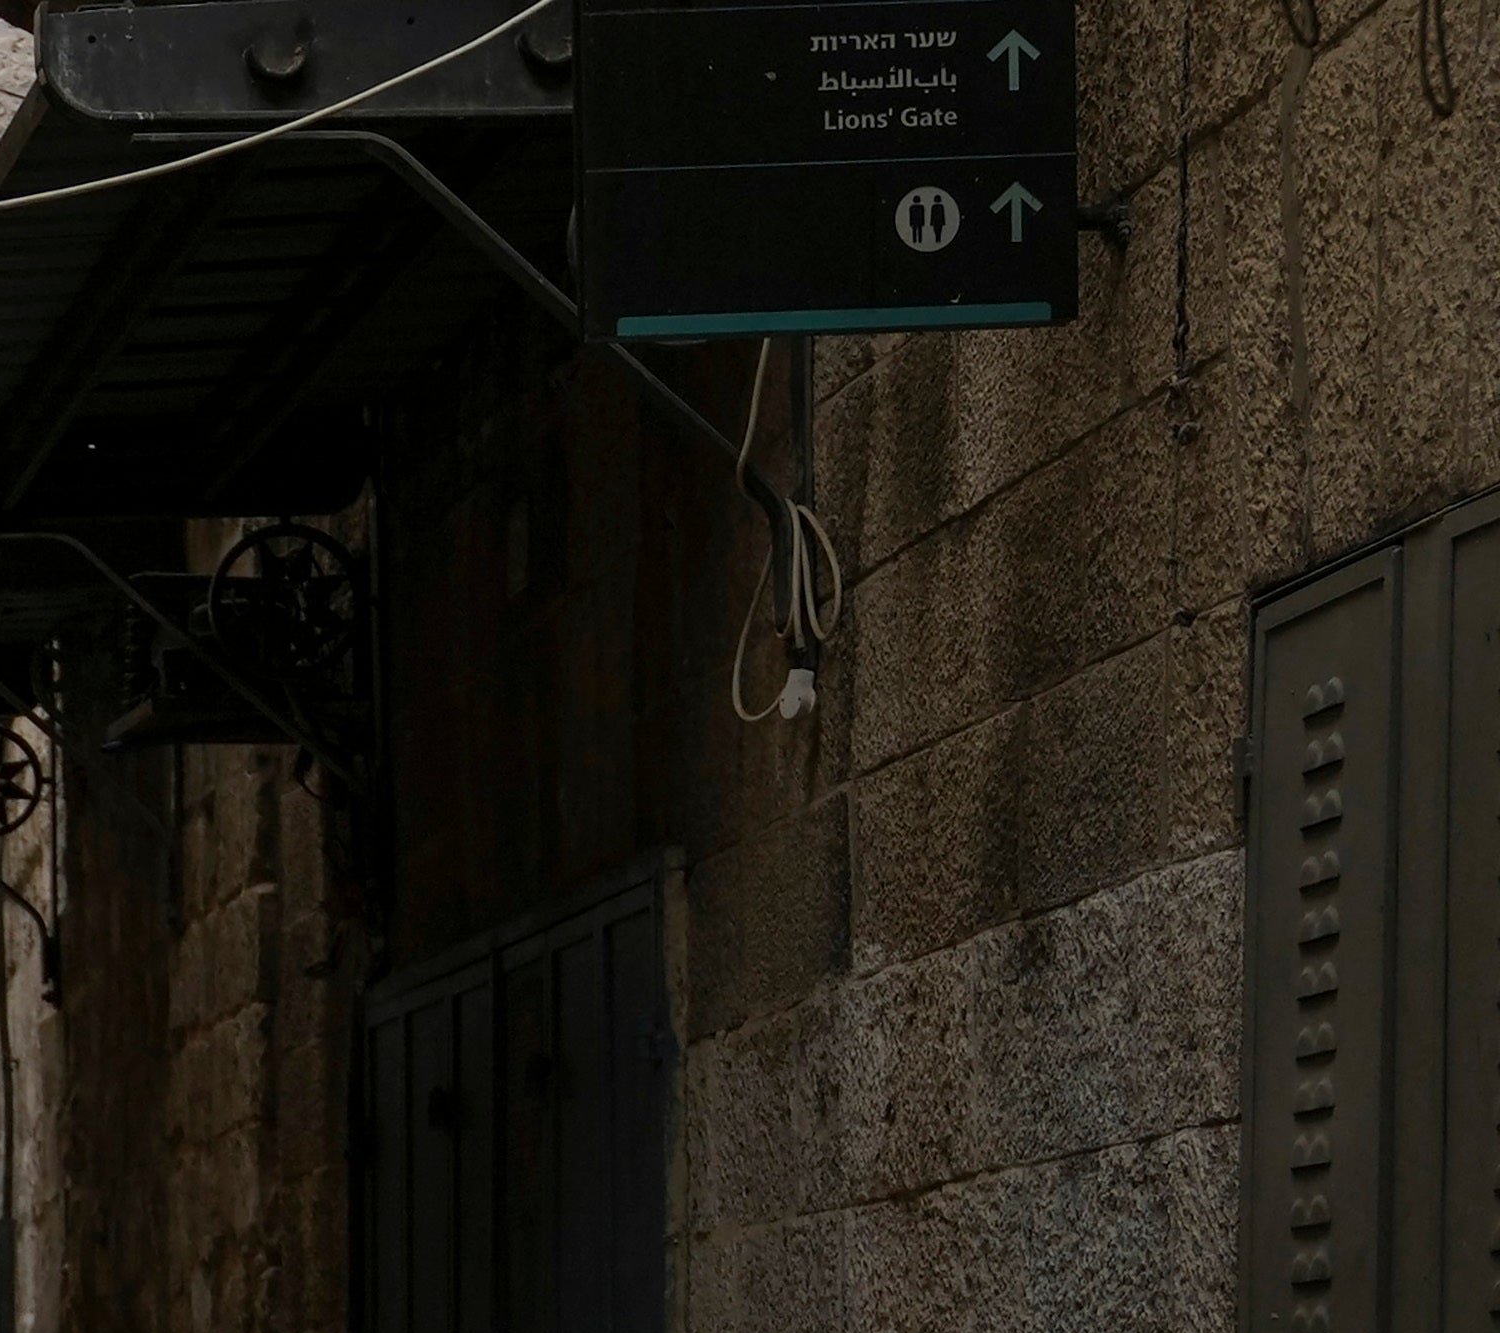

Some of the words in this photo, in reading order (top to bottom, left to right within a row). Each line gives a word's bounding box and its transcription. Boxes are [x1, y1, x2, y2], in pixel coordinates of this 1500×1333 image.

[810, 34, 895, 52] האריות
[904, 31, 957, 48] שער
[824, 109, 893, 130] Lions'
[900, 107, 958, 127] Gate
